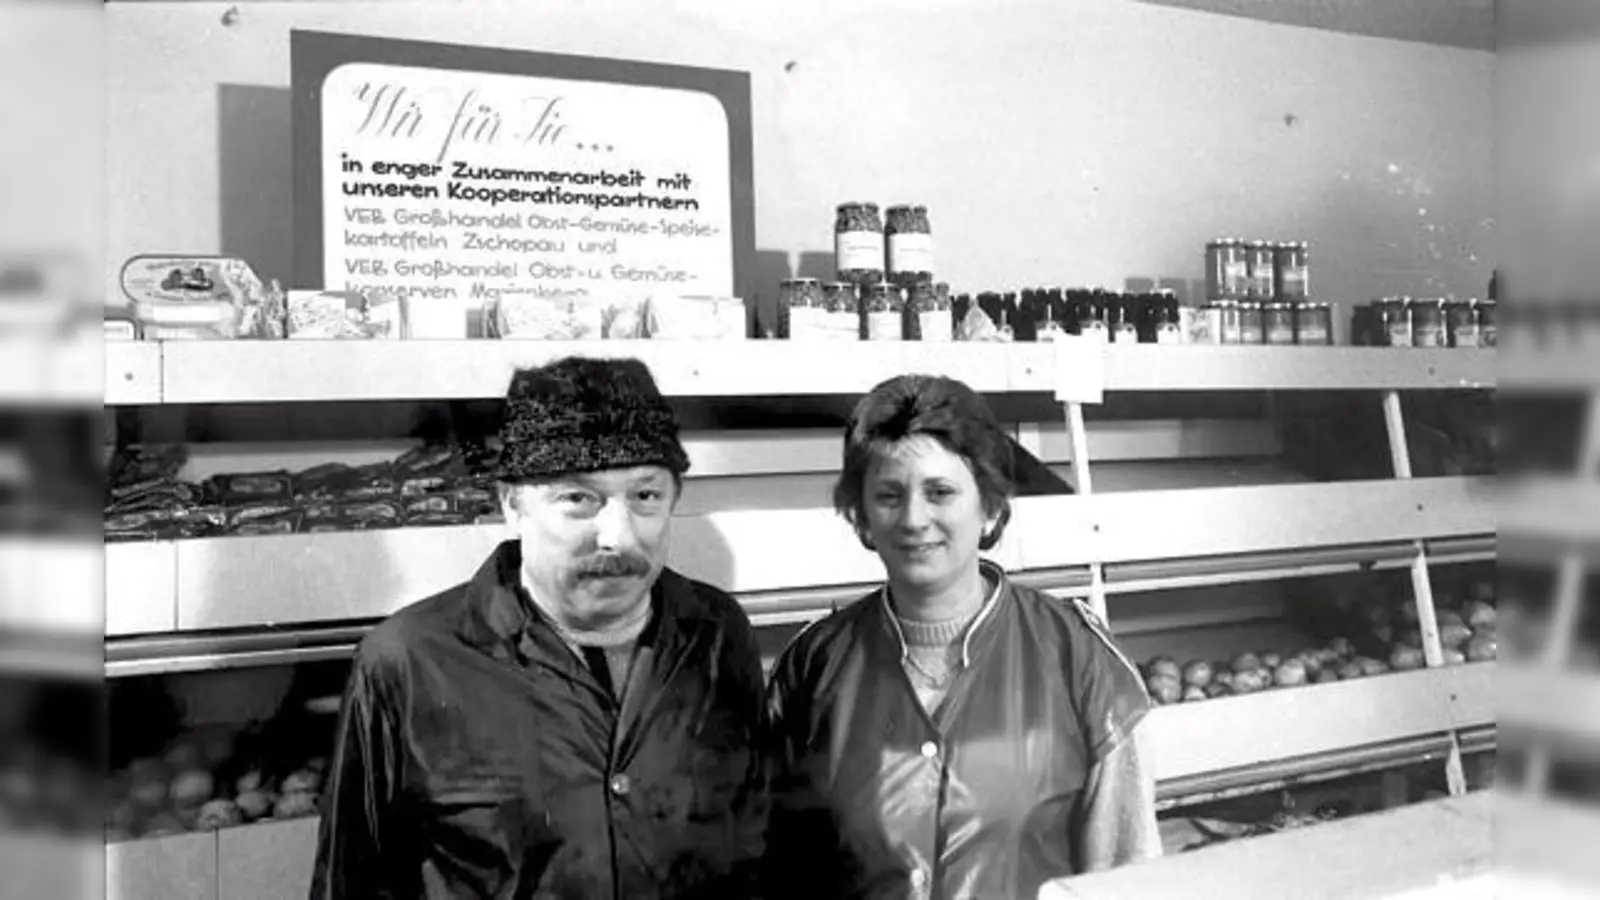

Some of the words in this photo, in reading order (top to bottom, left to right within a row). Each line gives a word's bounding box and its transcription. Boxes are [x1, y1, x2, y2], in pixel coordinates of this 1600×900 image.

[352, 82, 423, 137] Wir
[437, 88, 503, 163] für
[341, 152, 364, 173] in
[371, 160, 443, 180] enger
[452, 160, 647, 188] Zusammenarbeit
[656, 172, 693, 191] mit
[341, 181, 439, 200] unseren
[447, 182, 700, 211] Kooperationspartnern
[344, 206, 387, 224] VEB
[393, 207, 522, 229] Großhandel
[344, 229, 449, 251] kartoffeln
[462, 231, 566, 254] Zschopau
[577, 237, 618, 255] und
[344, 258, 389, 276] VEB
[394, 259, 518, 280] Großhandel
